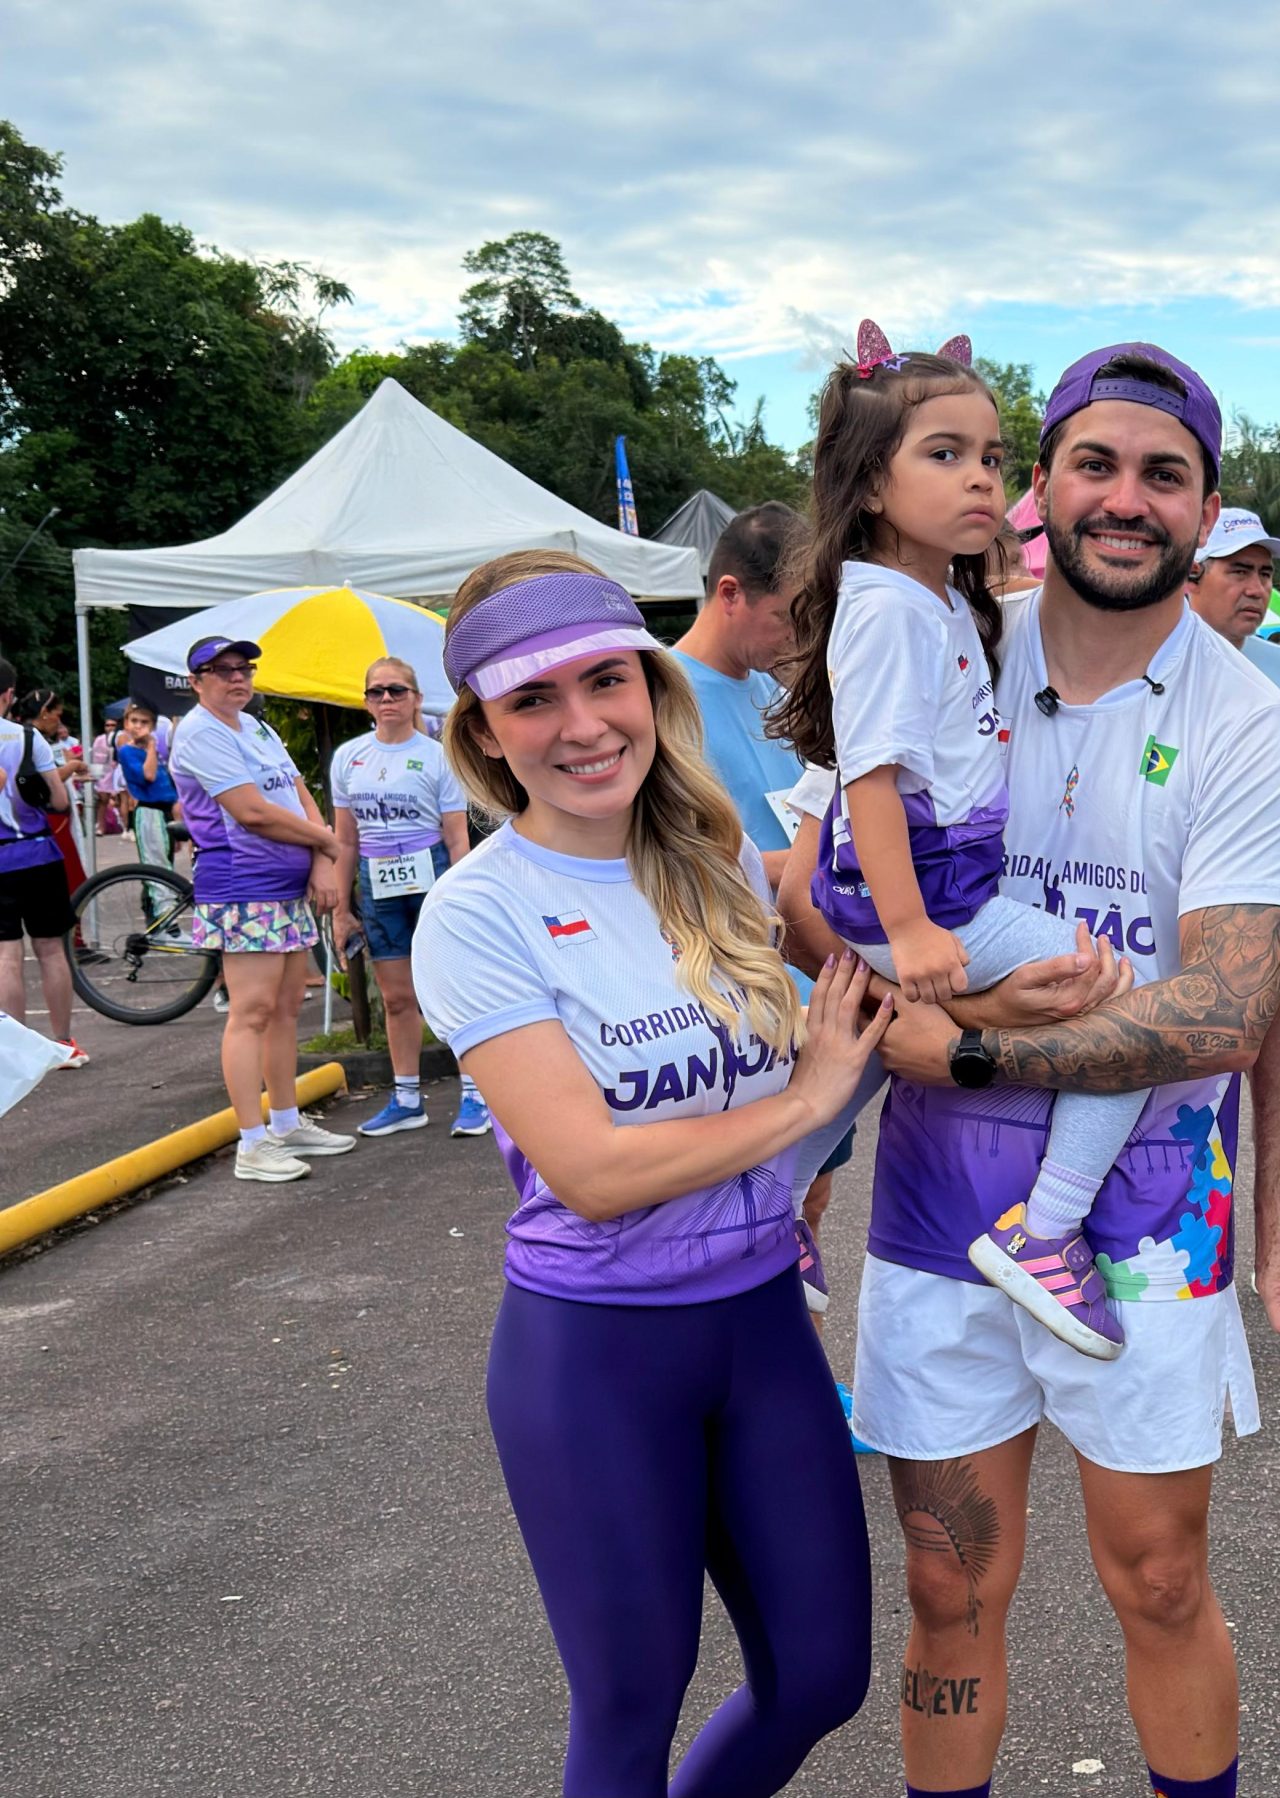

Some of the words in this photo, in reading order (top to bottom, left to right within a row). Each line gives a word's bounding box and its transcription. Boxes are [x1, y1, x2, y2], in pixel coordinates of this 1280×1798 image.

[379, 866, 416, 883] 2151
[1061, 860, 1126, 891] AMIGOS
[600, 1002, 705, 1047] CORRIDA
[603, 1047, 717, 1111] JAN
